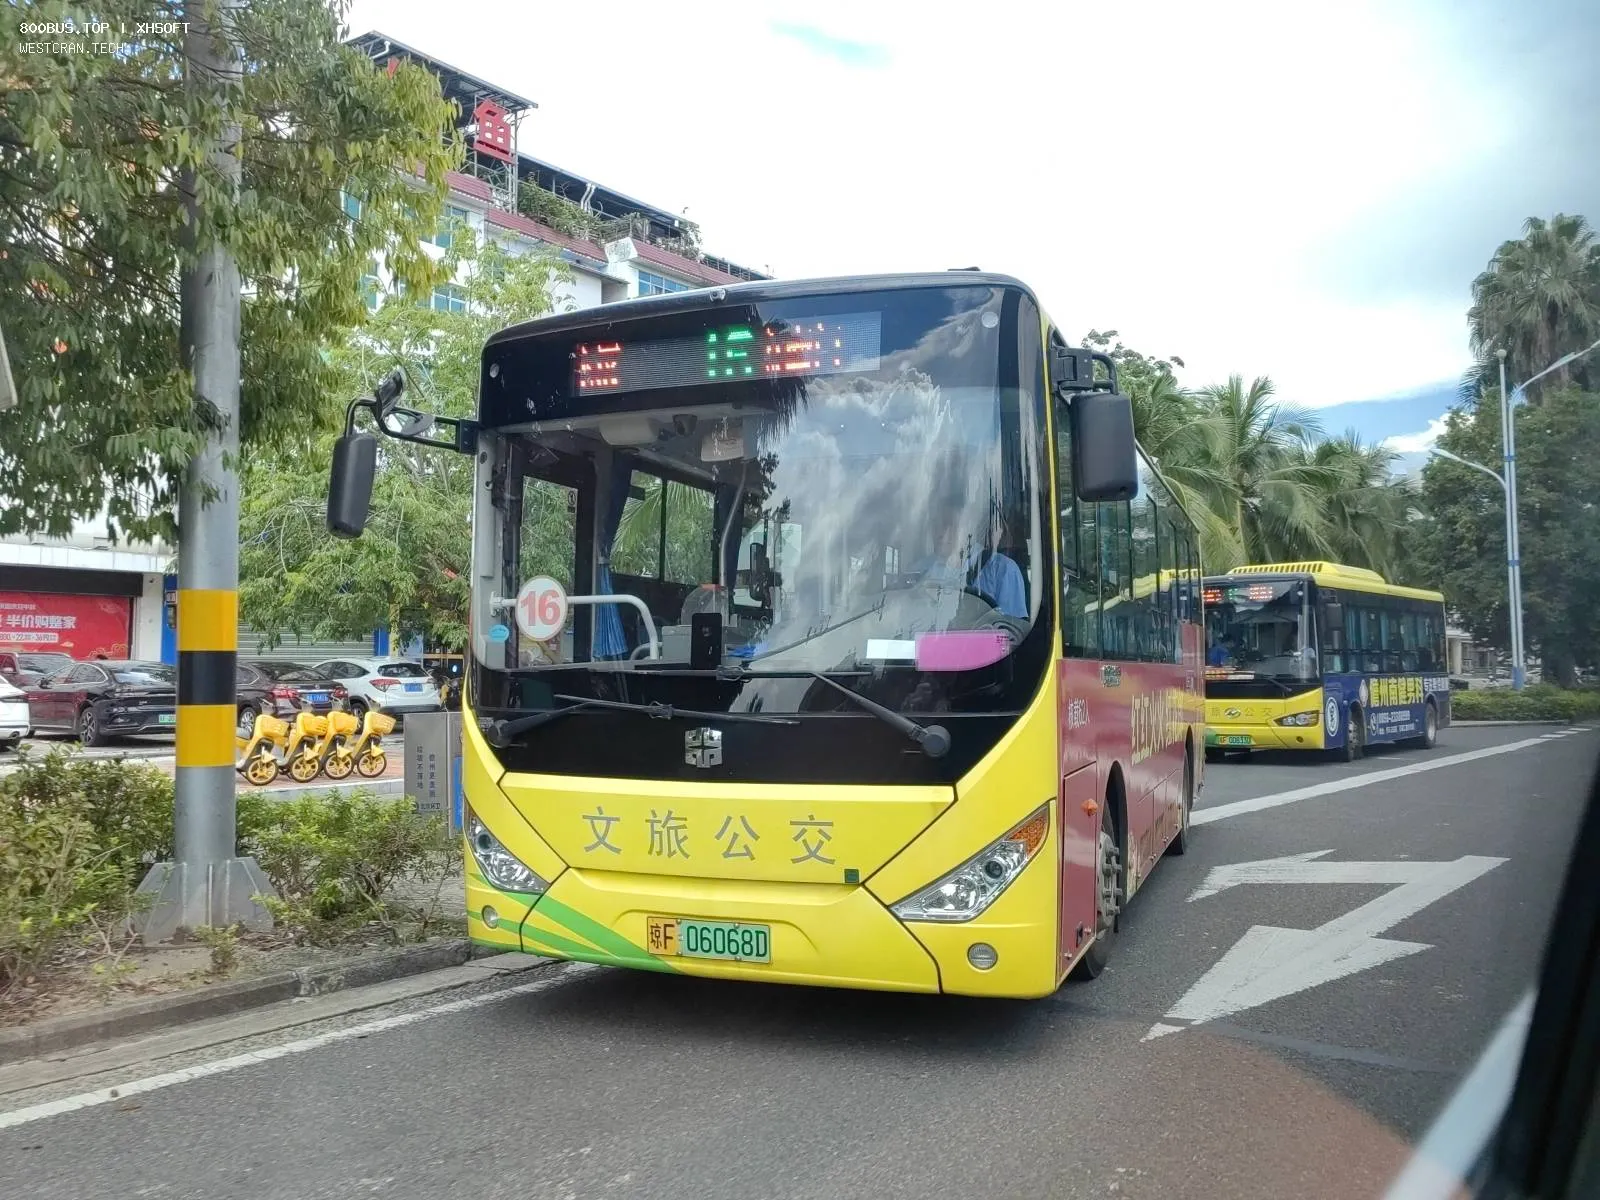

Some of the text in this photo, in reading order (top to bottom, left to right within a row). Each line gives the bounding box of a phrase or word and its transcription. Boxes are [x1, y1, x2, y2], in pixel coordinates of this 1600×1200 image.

[520, 589, 561, 627] 16
[582, 806, 836, 865] 文旅公交
